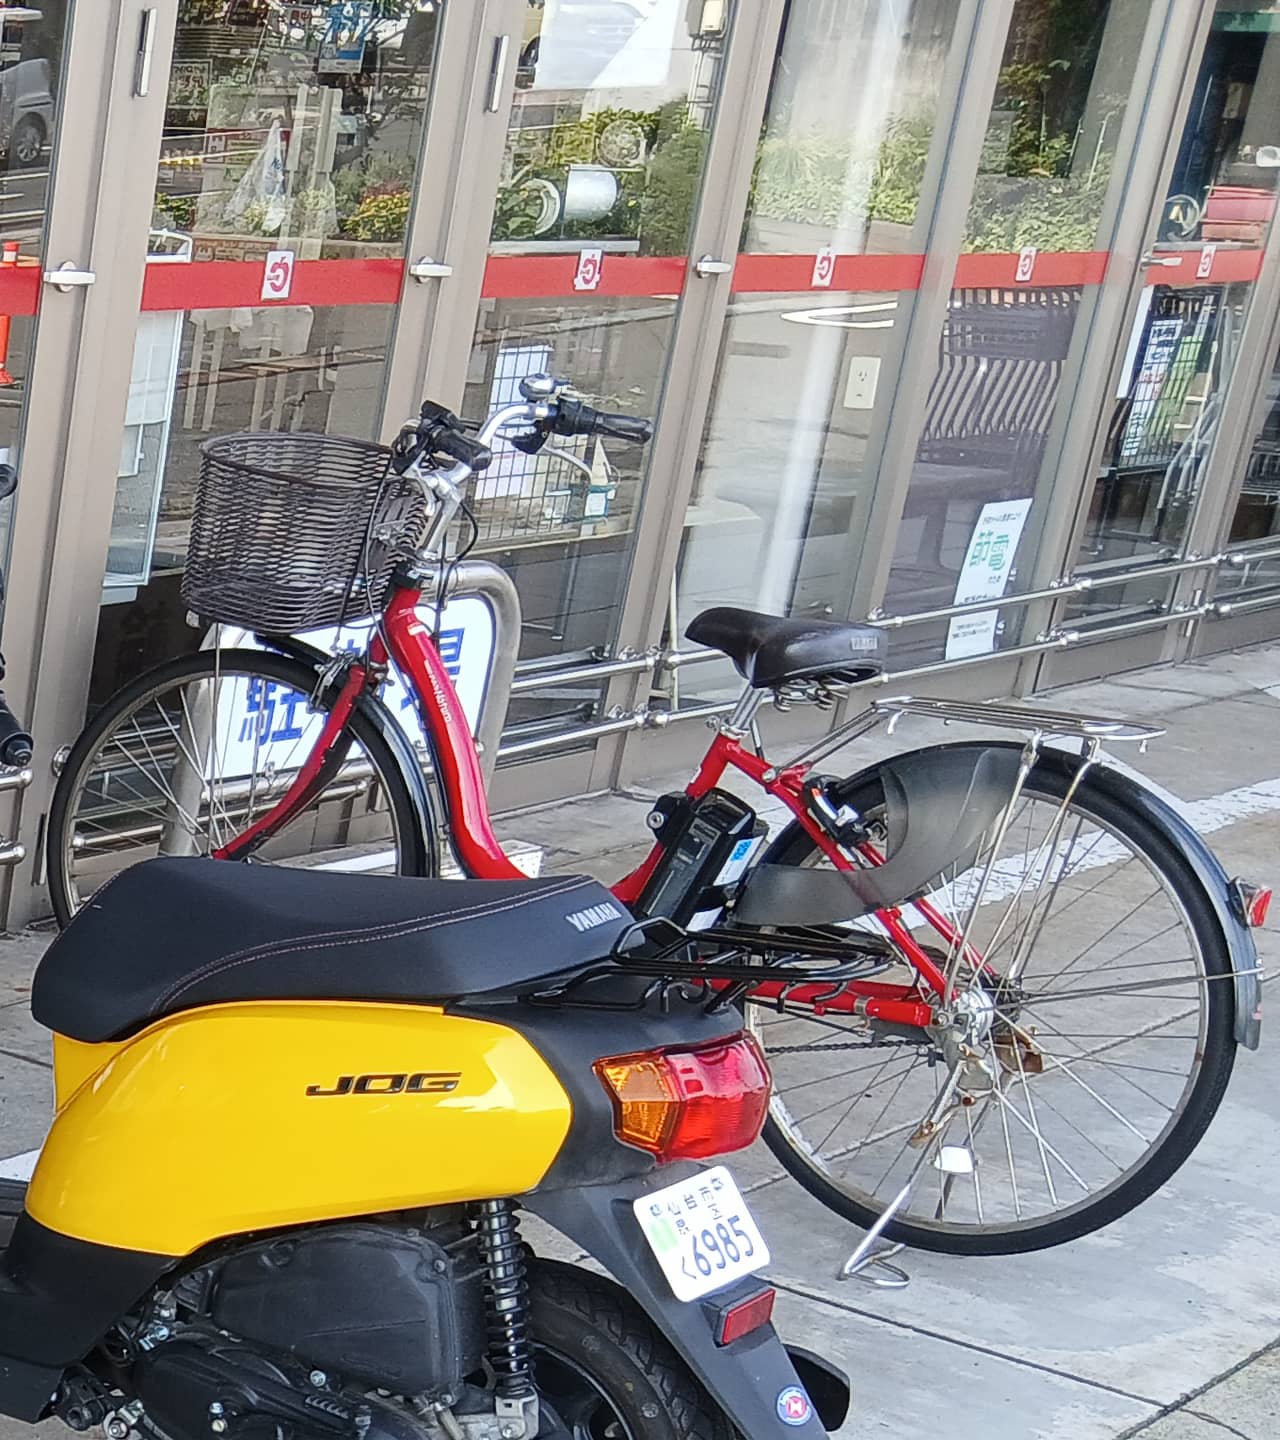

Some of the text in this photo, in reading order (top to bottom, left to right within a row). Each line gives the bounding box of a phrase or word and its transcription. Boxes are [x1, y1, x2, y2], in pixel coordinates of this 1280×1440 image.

[564, 901, 623, 932] YAMAHA
[305, 1071, 462, 1097] JOG
[692, 1214, 754, 1276] 6985
